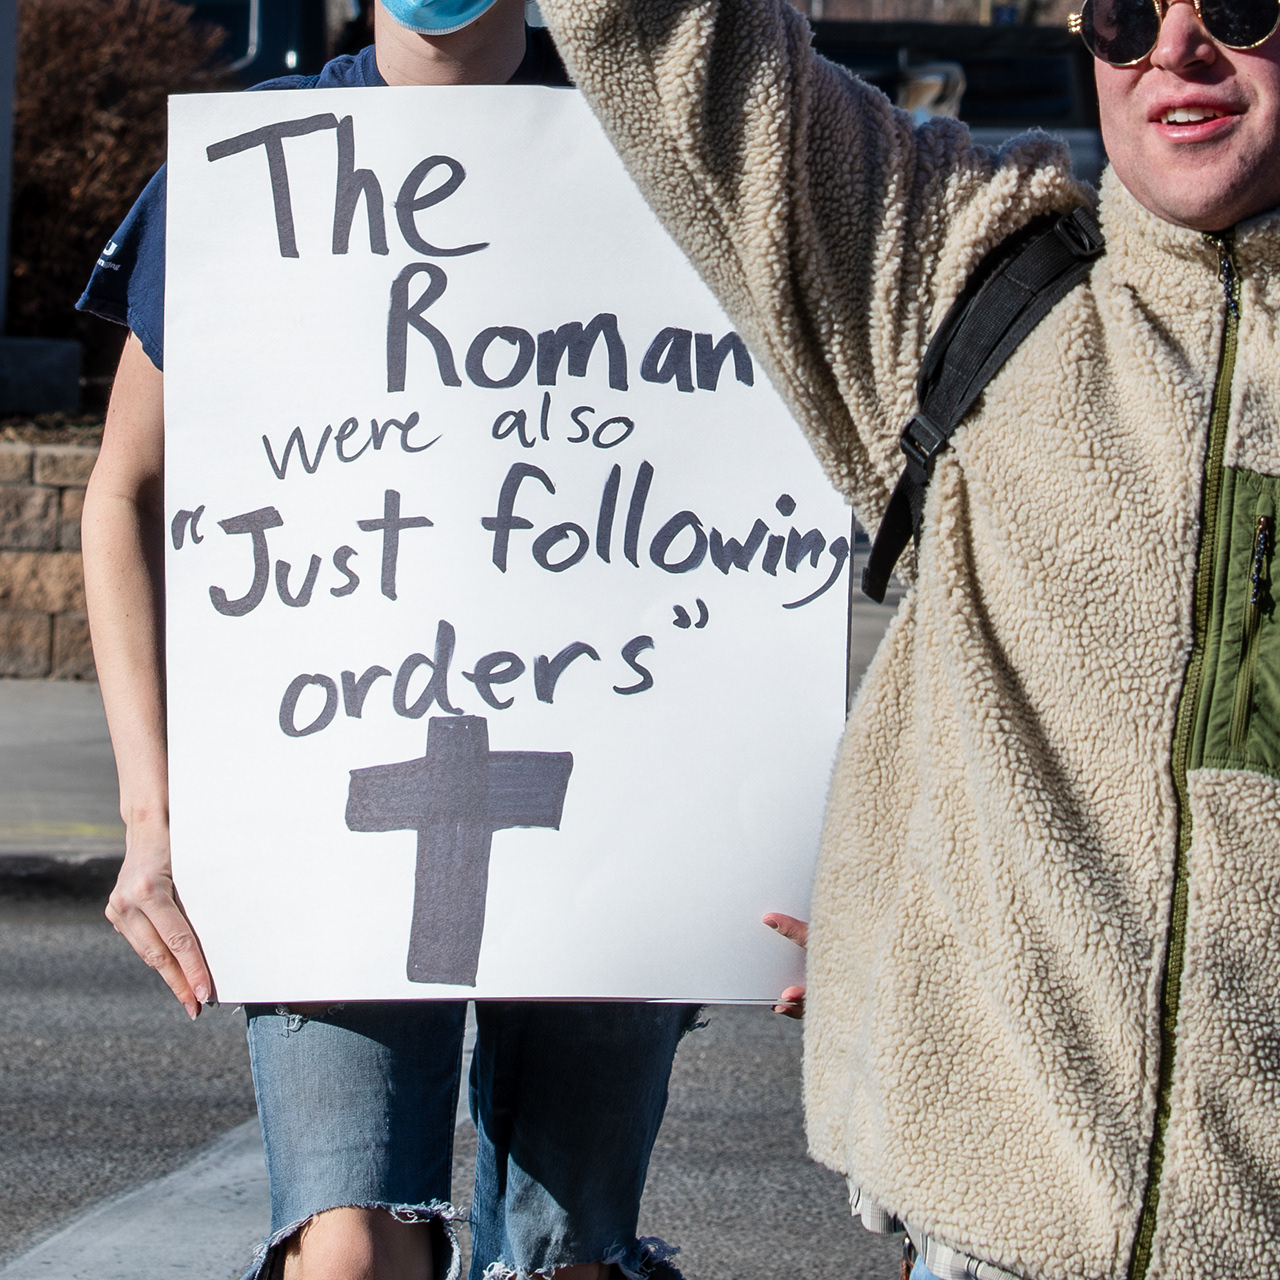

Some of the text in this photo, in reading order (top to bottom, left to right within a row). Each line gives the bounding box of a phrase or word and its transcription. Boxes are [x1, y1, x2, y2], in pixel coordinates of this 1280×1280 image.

[205, 112, 490, 259] The
[386, 262, 755, 393] Roman
[262, 391, 635, 480] were also
[480, 459, 850, 610] following
